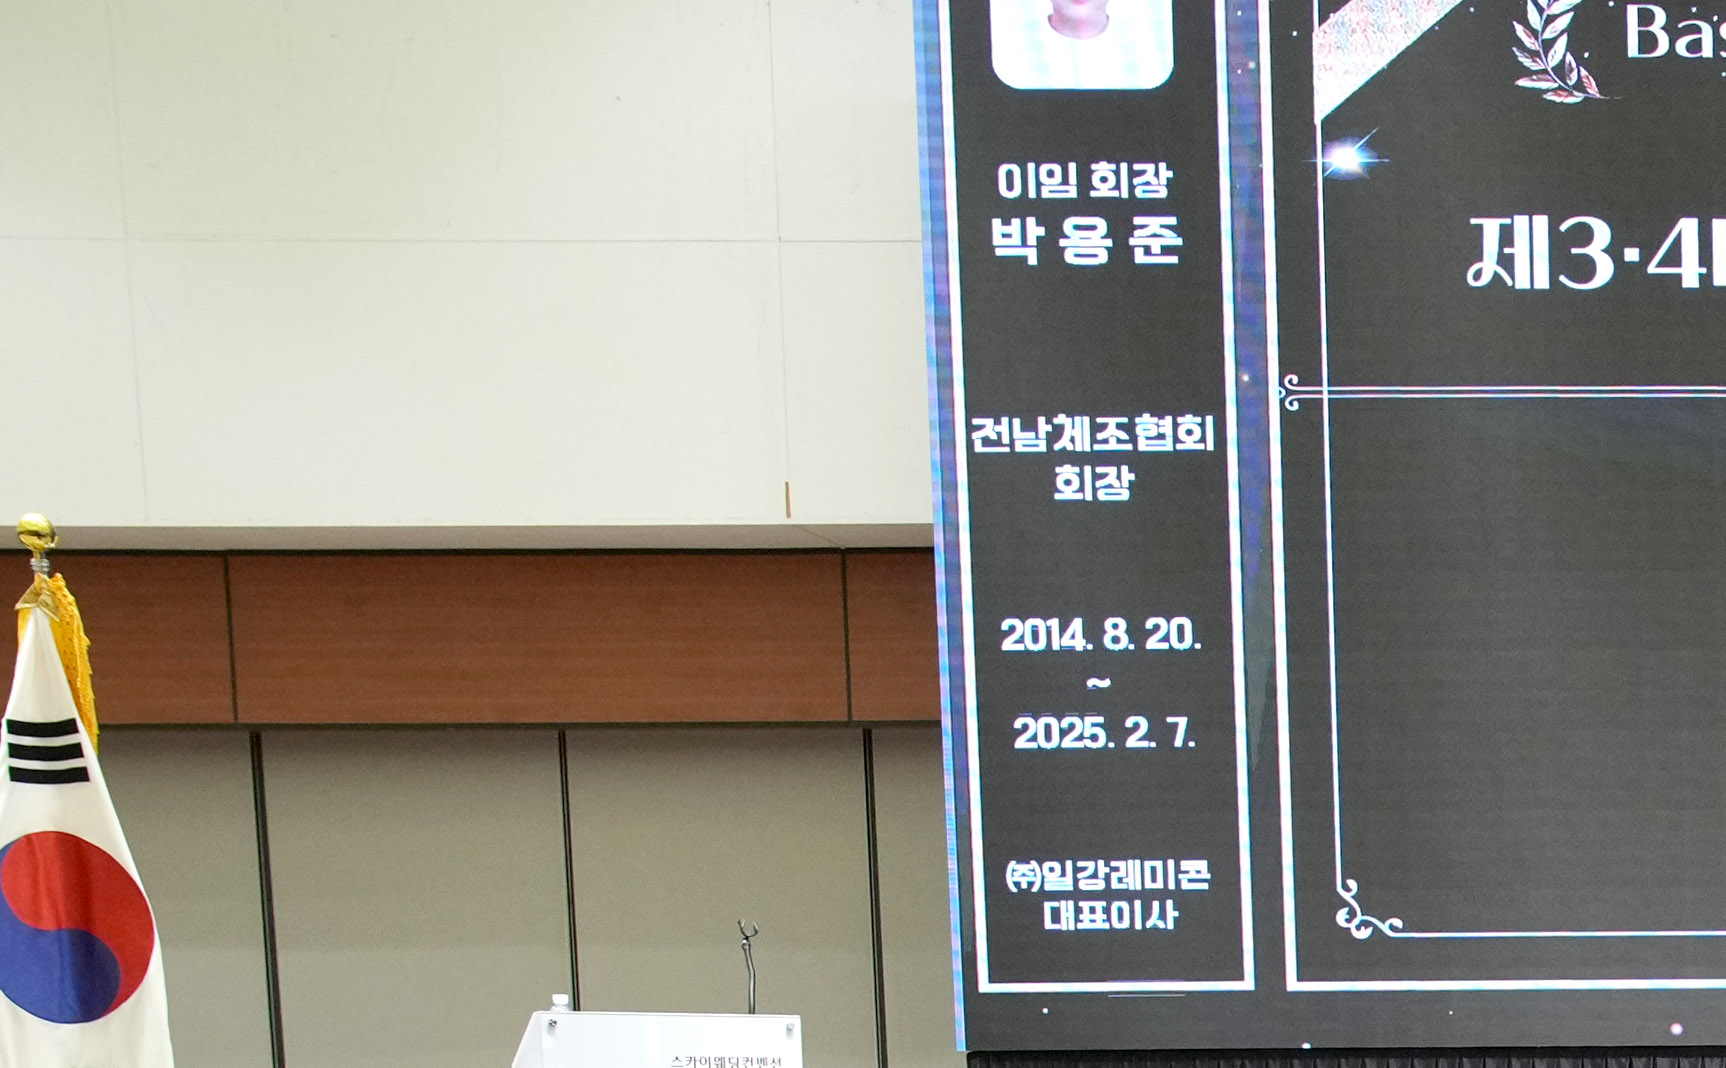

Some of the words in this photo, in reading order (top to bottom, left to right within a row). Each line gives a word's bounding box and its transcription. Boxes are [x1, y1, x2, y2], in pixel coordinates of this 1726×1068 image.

[998, 162, 1077, 198] 이임
[1090, 161, 1173, 198] 회장
[972, 413, 1214, 452] 전남체조협회
[1054, 464, 1135, 501] 회장
[1001, 618, 1093, 651] 2014.
[1103, 617, 1134, 651] 8.
[1145, 617, 1201, 650] 20.
[1014, 716, 1115, 749] 2025.
[1125, 716, 1156, 747] 2.
[1166, 717, 1195, 747] 7.
[1044, 899, 1179, 930] 대표이사
